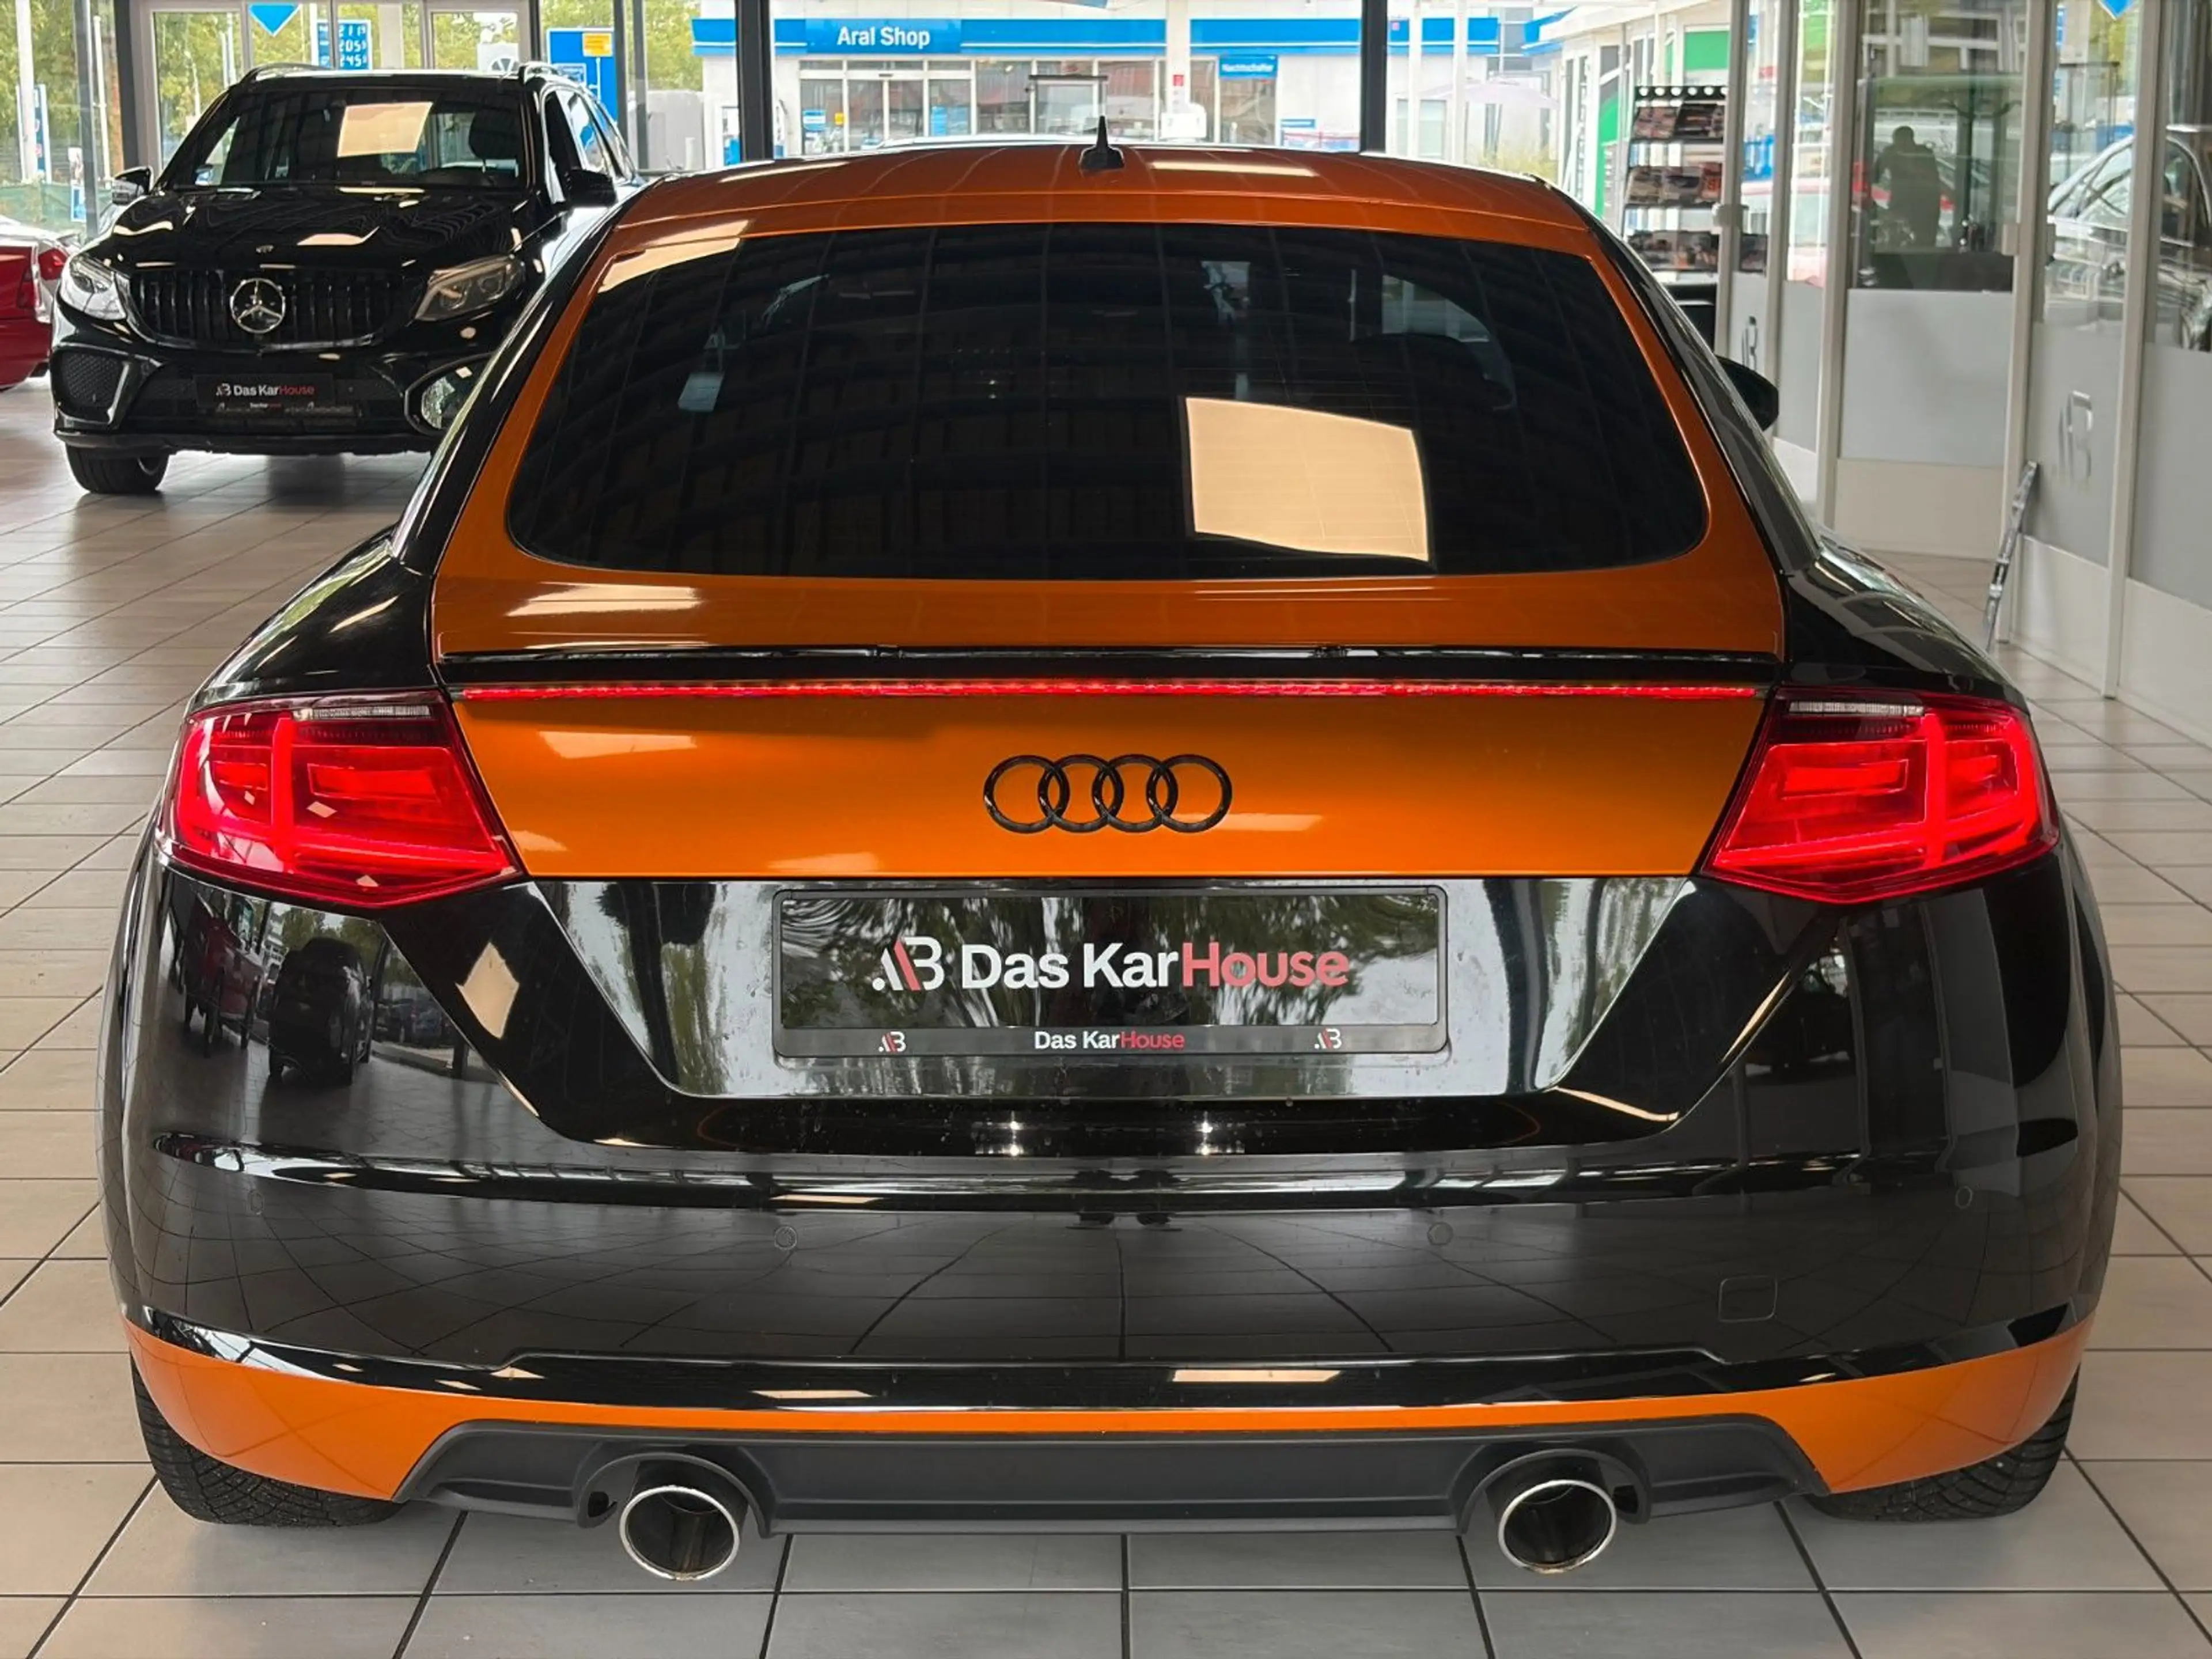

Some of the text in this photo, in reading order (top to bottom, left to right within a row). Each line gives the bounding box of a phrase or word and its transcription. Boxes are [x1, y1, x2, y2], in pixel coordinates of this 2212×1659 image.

[837, 26, 930, 50] Aral Shop
[233, 385, 257, 396] Das
[259, 384, 315, 396] KarHouse
[961, 944, 1069, 989] Das
[1084, 942, 1350, 988] KarHouse
[1034, 1030, 1185, 1050] Das KarHouse
